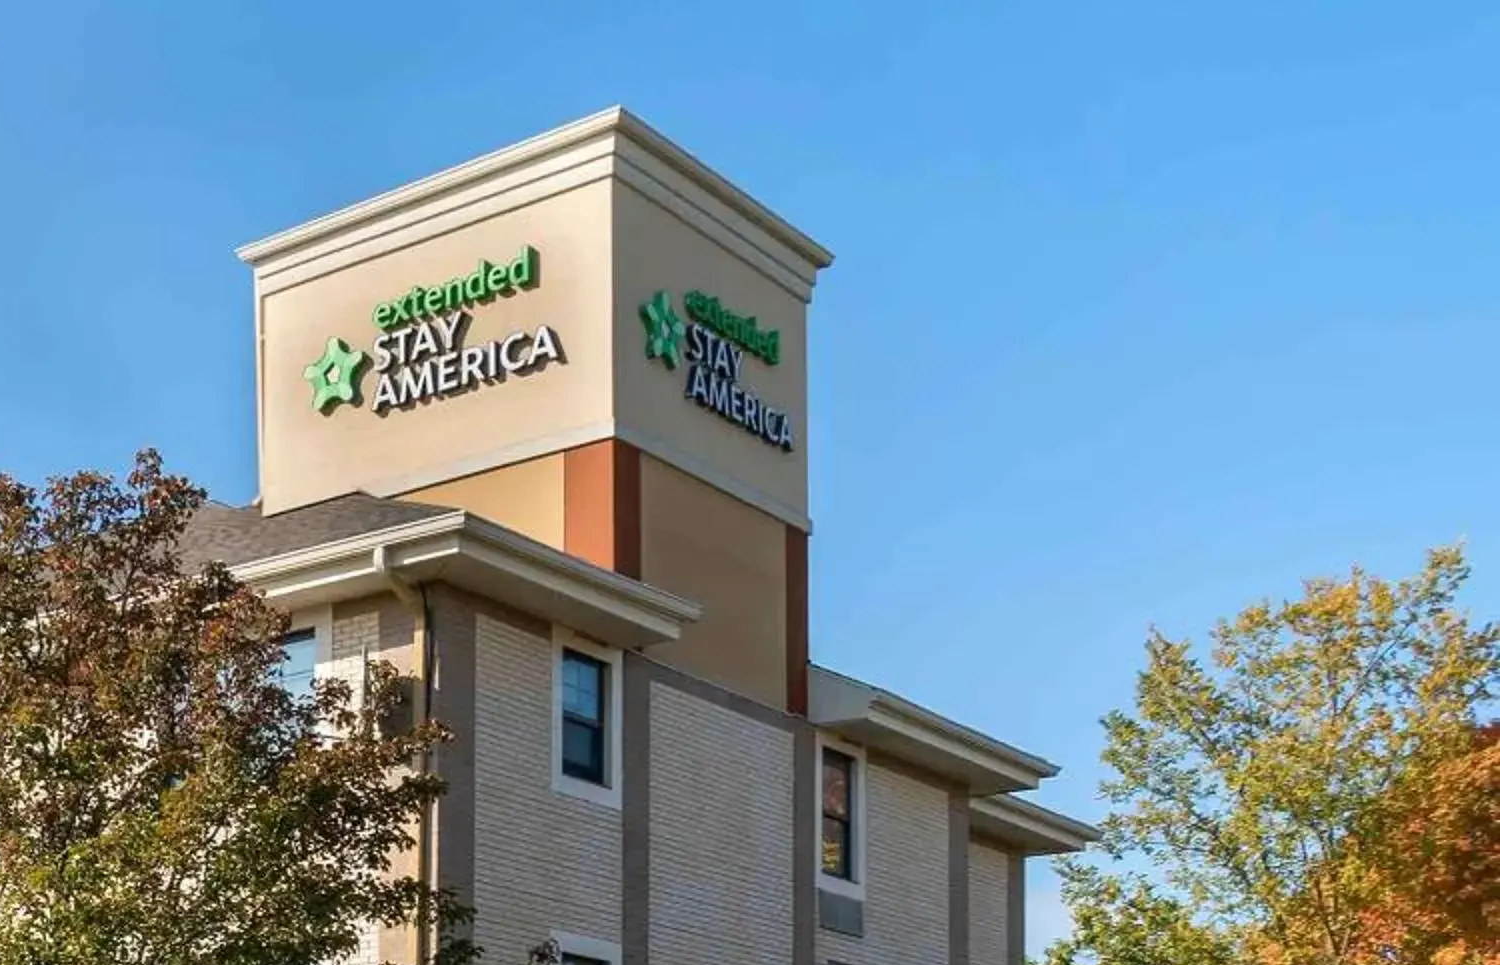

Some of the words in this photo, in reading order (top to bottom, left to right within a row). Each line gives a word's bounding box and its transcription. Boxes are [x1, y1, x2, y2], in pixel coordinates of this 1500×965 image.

[372, 245, 534, 330] extended
[372, 325, 560, 411] AMERICA
[374, 311, 463, 372] STAY
[689, 322, 743, 379] STAY
[689, 364, 793, 446] AMERICA
